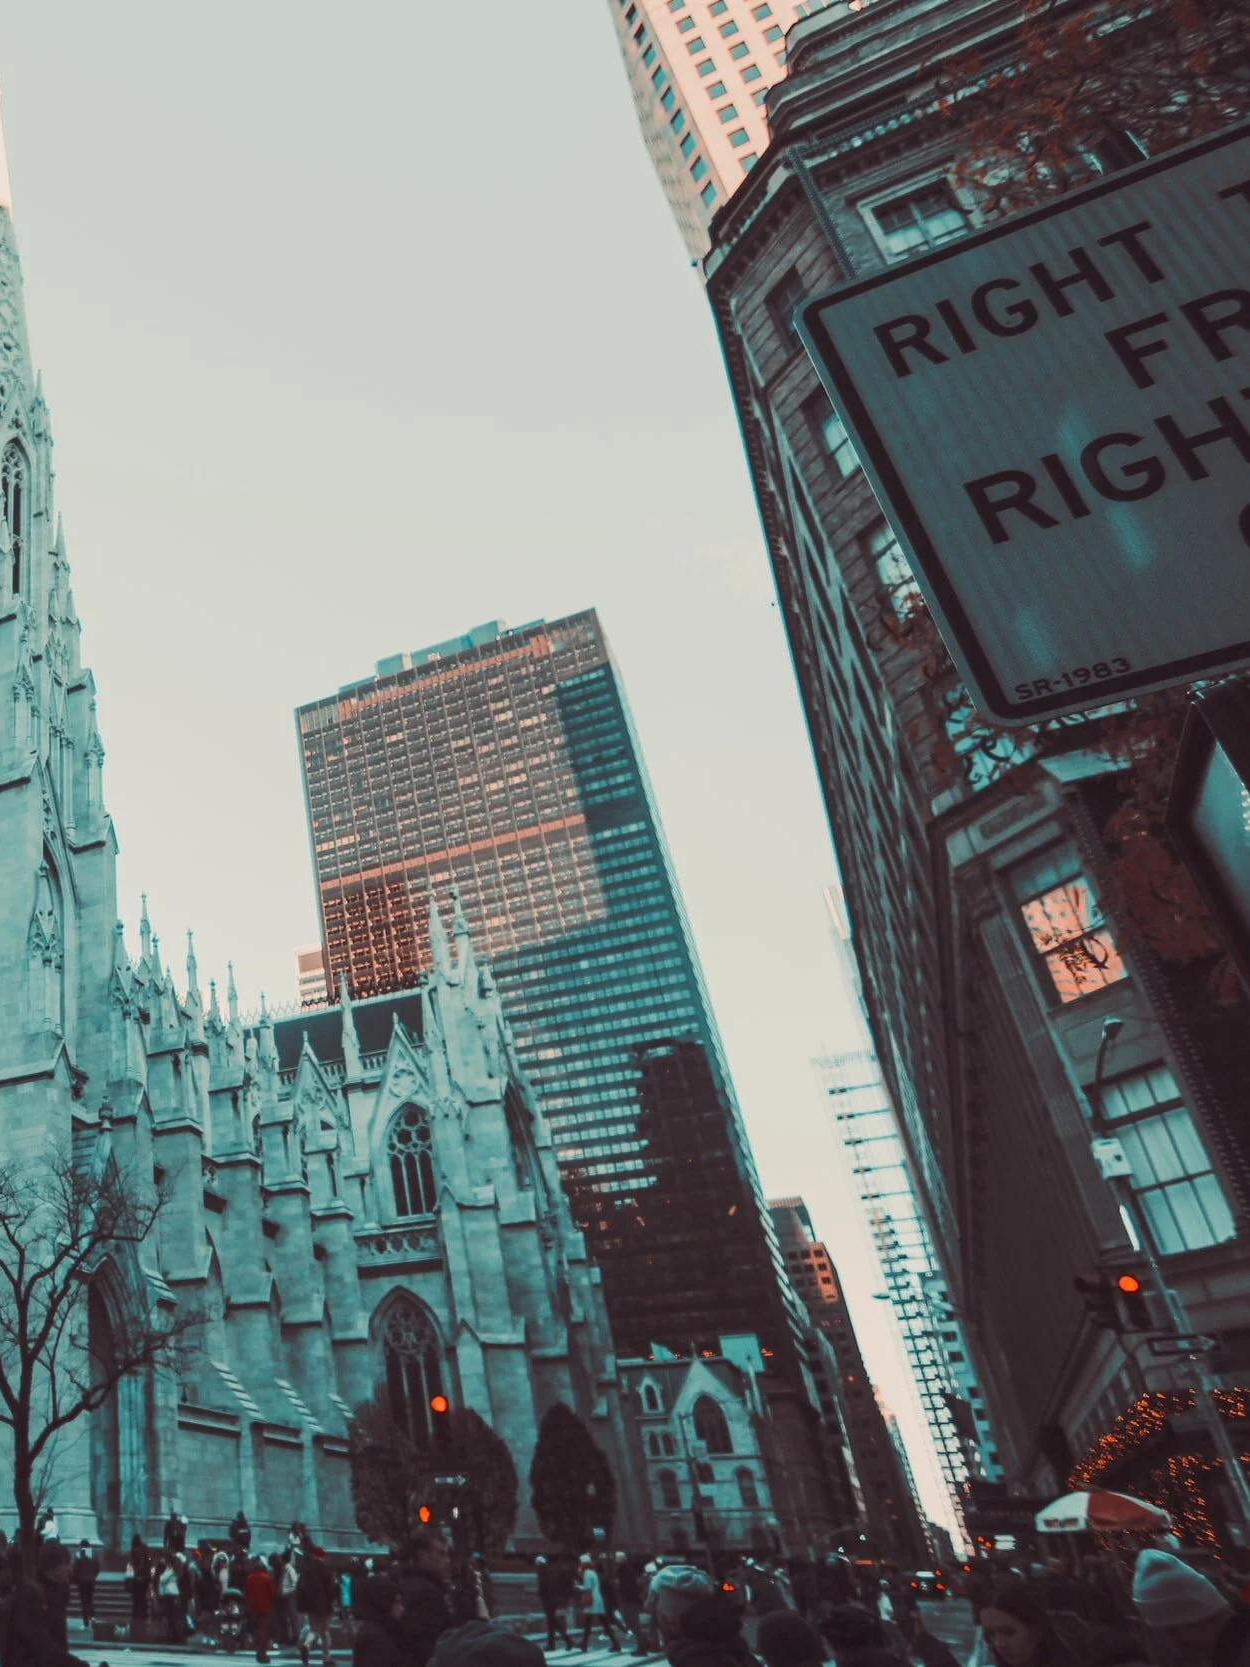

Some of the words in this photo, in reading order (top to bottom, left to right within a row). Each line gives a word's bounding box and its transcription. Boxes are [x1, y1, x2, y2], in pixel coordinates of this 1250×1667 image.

[873, 221, 1165, 378] RIGHT
[963, 387, 1250, 545] RIGH
[1015, 657, 1131, 699] SR-1983
